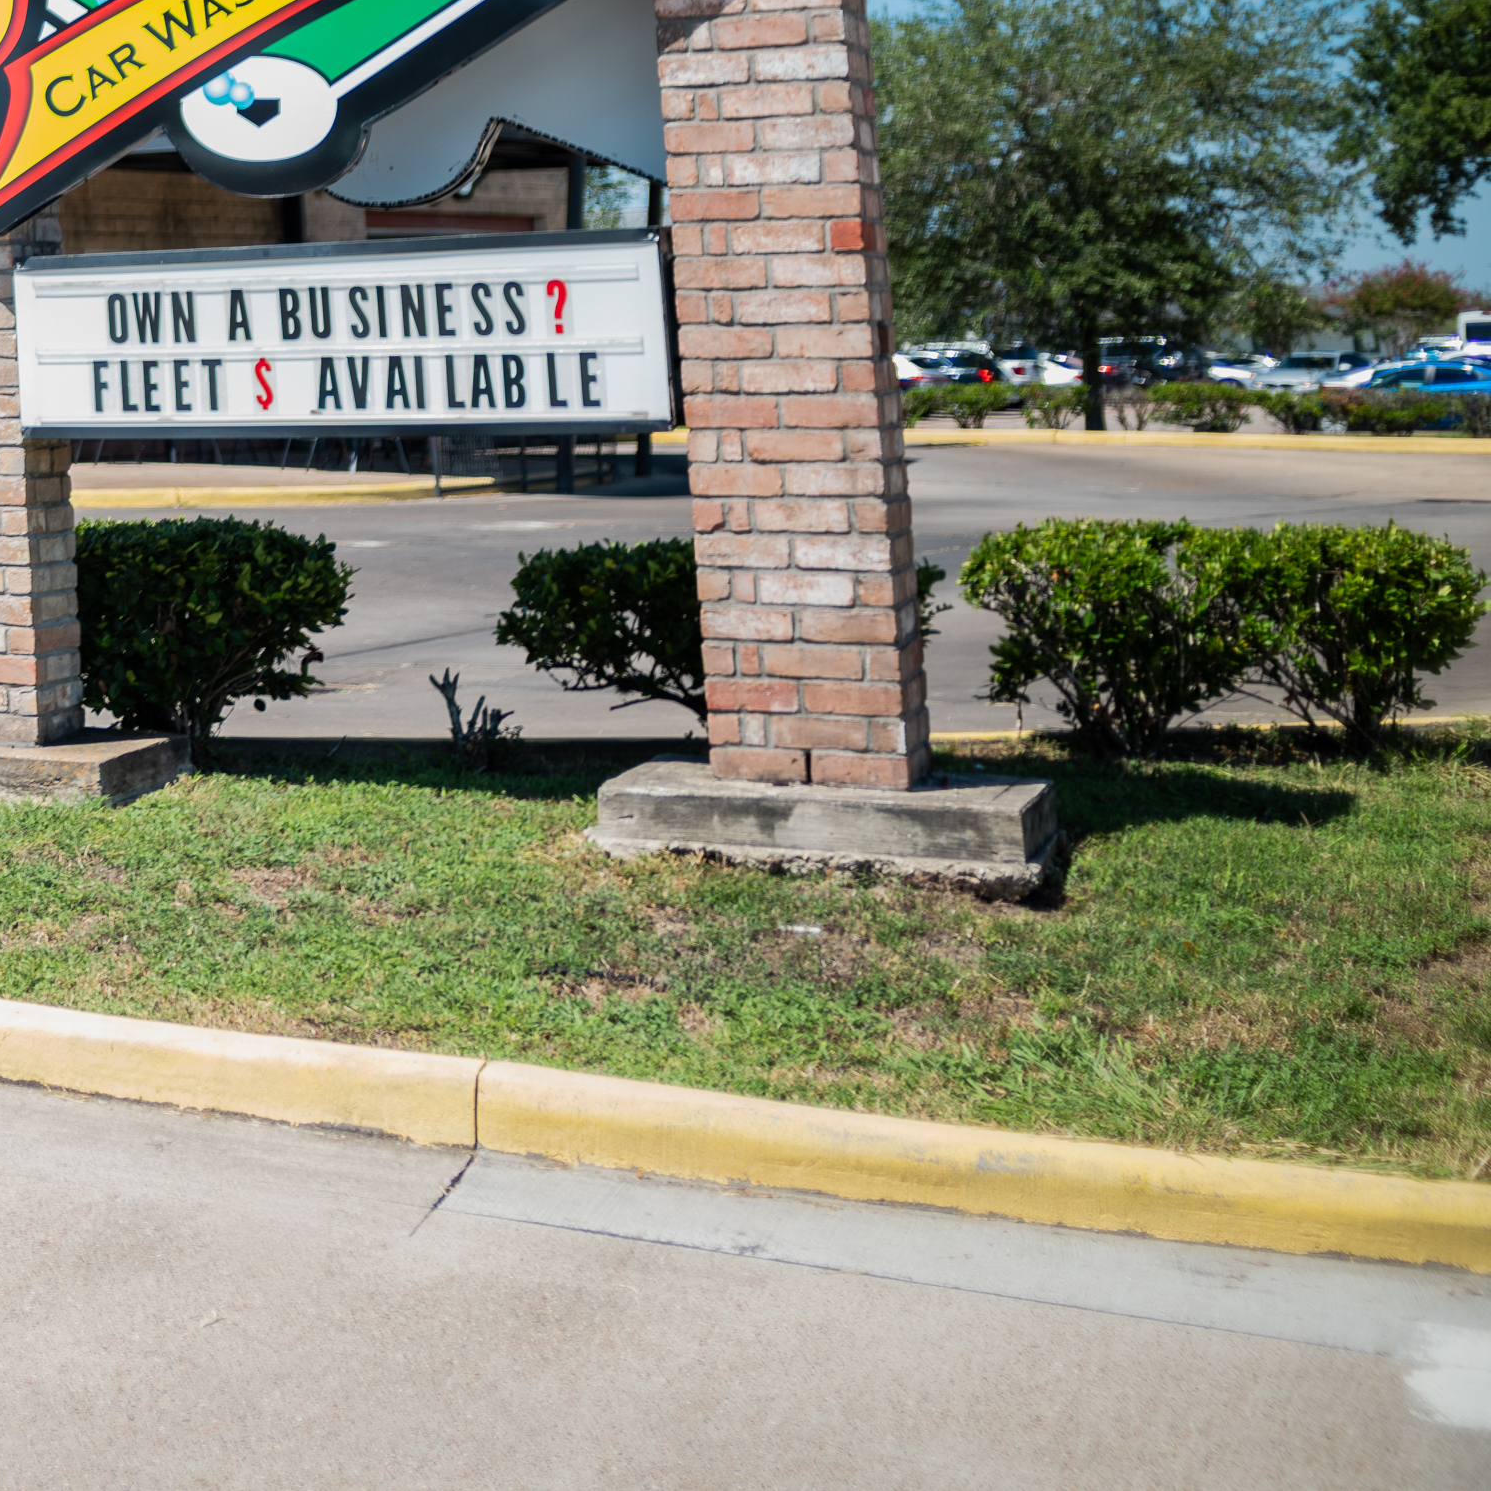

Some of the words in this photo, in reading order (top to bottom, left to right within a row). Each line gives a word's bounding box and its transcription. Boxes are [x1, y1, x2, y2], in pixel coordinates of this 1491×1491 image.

[44, 41, 148, 116] CAR
[108, 290, 197, 344] OWN
[228, 289, 253, 342] A
[92, 358, 222, 412] FLEET
[254, 357, 275, 411] $
[317, 351, 602, 410] AVAILABLE
